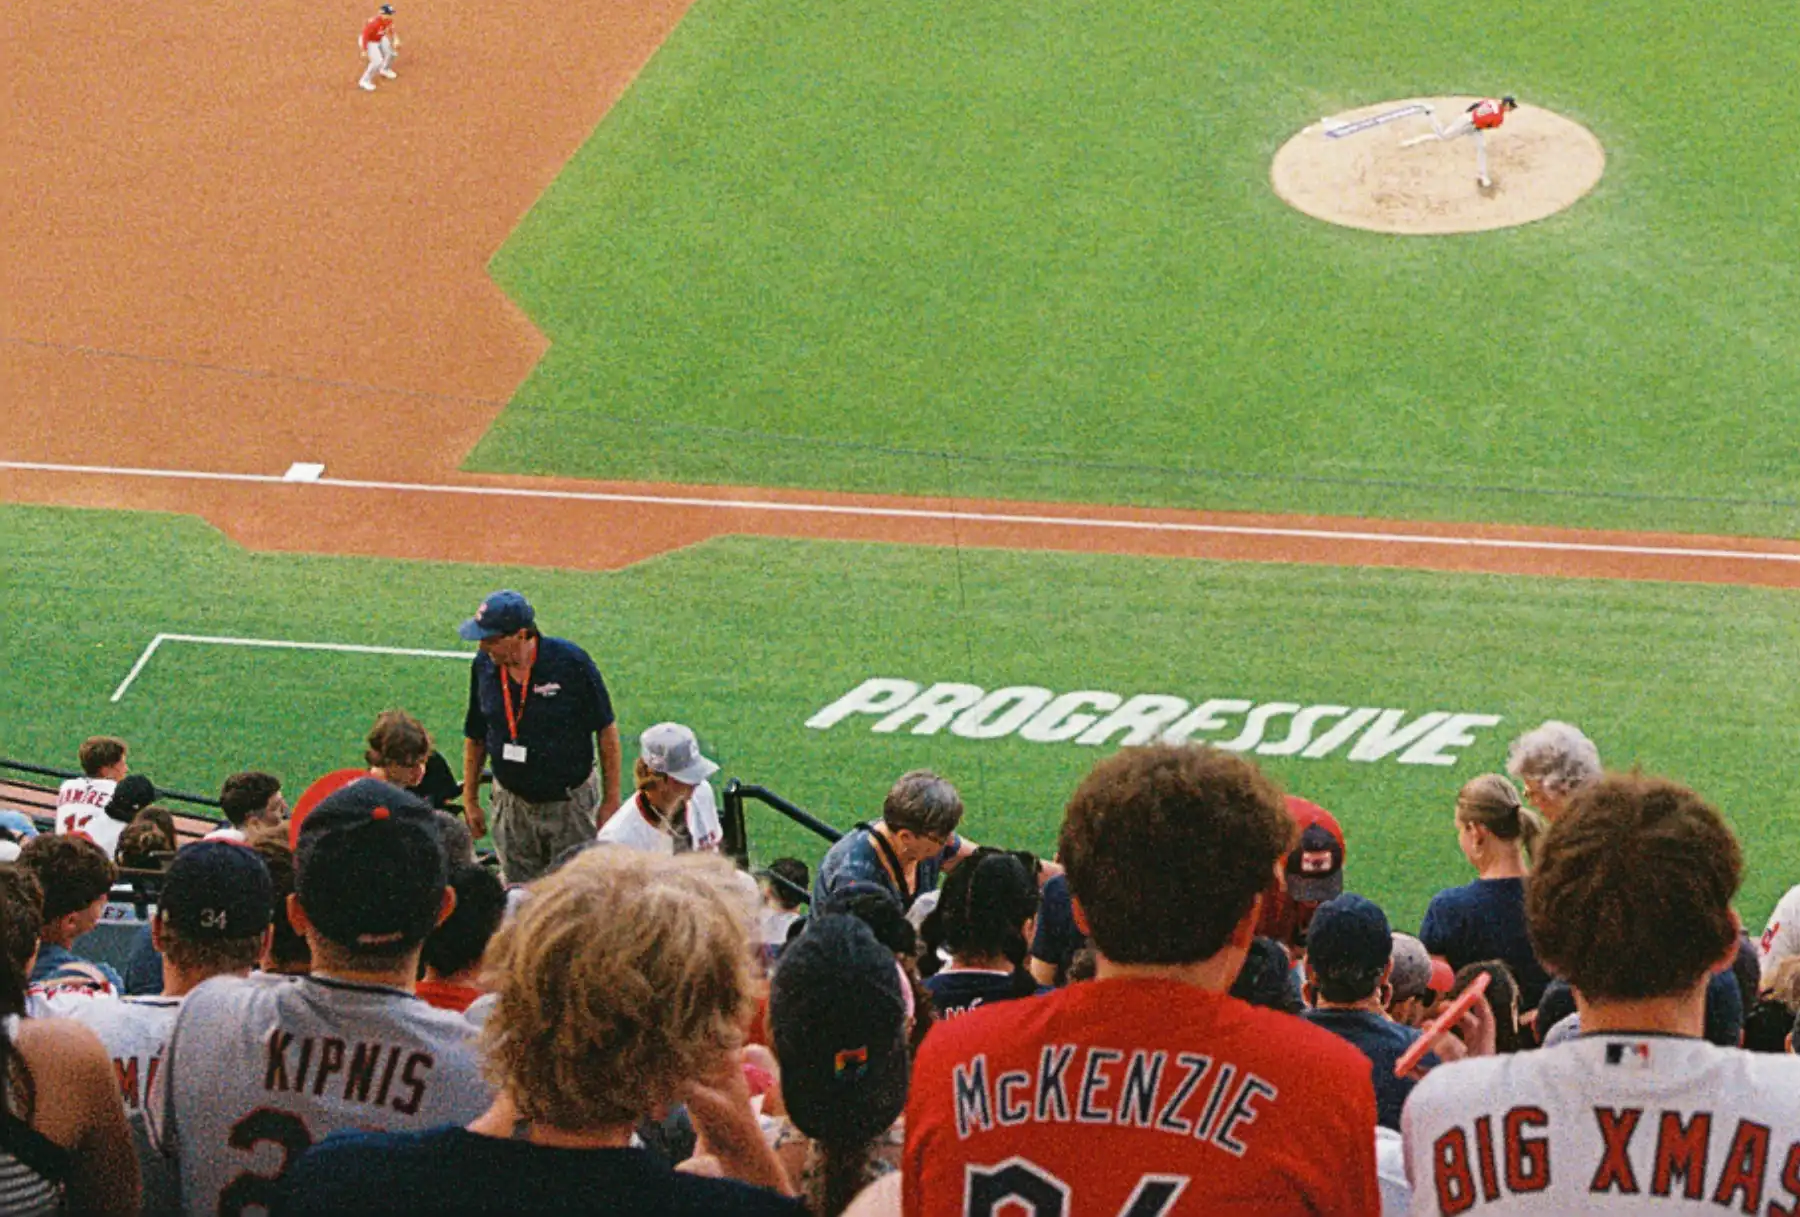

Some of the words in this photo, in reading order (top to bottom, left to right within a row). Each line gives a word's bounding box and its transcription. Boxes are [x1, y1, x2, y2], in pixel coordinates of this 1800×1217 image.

[804, 677, 1504, 766] PROGRESSIVE
[200, 908, 228, 930] 34
[264, 1027, 434, 1116] KIPNIS
[952, 1044, 1278, 1158] McKENZIE
[1433, 1105, 1551, 1217] BIG
